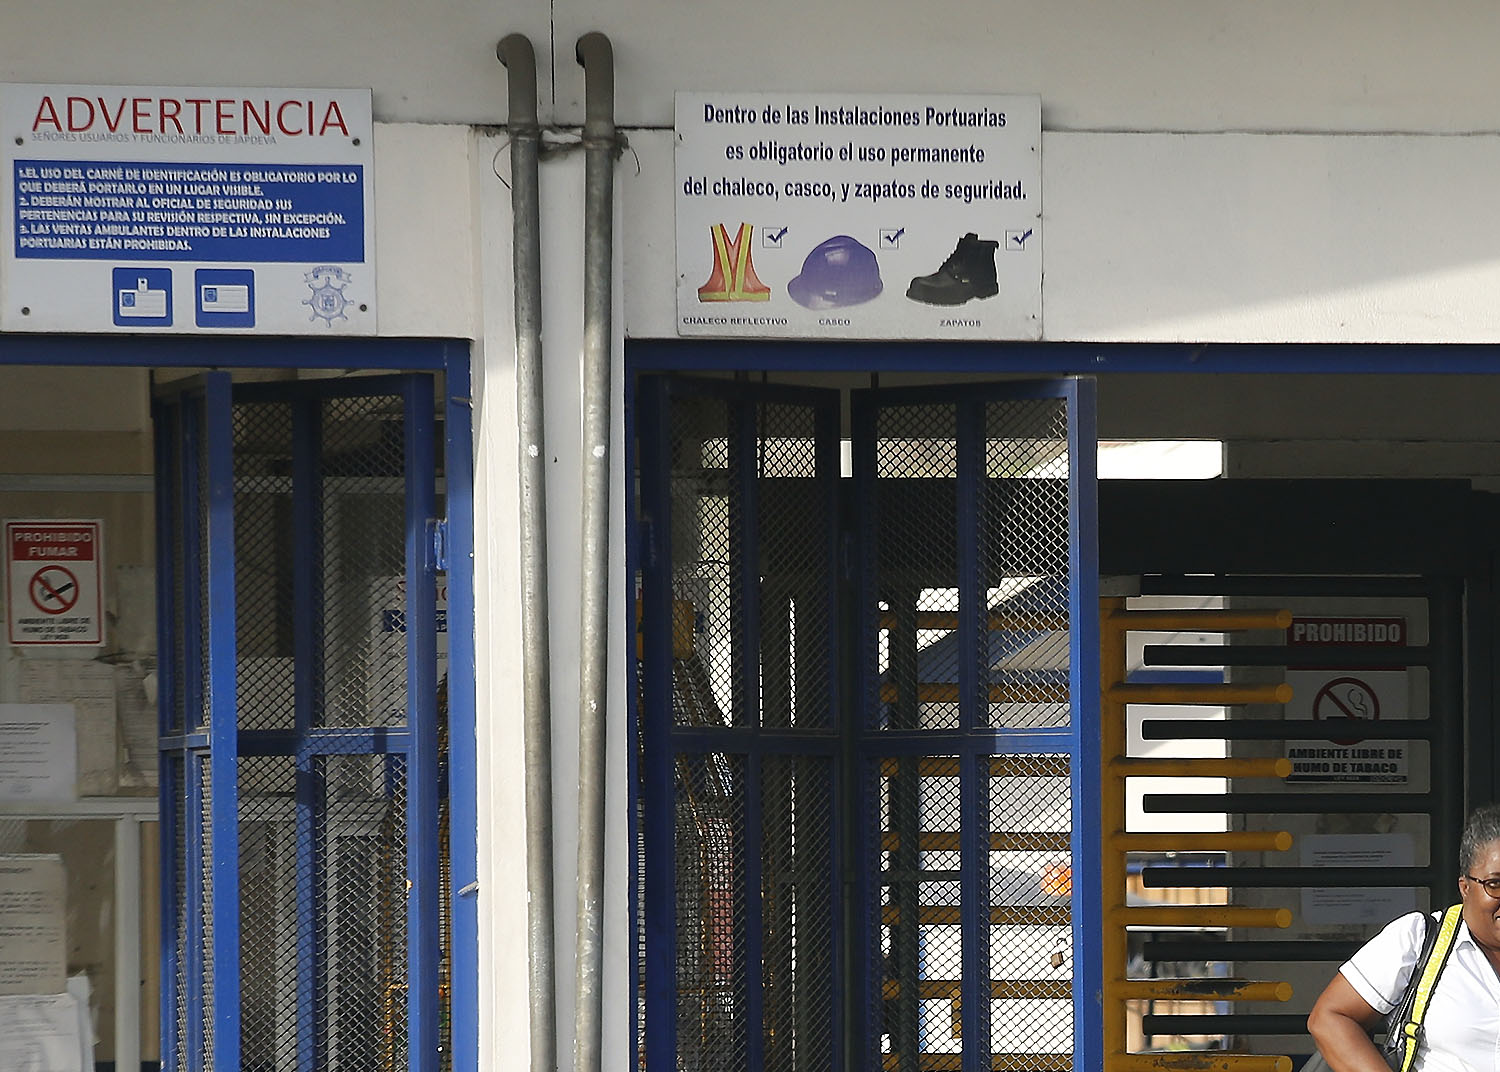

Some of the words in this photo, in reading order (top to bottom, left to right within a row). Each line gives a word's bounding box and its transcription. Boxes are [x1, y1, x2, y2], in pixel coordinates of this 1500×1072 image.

[32, 96, 349, 137] ADVERTENCIA
[704, 104, 757, 124] Dentro
[762, 105, 781, 125] de
[786, 105, 809, 125] las
[815, 105, 921, 127] Instalaciones
[925, 106, 1007, 128] Portuarias
[78, 133, 129, 144] USUARIOS
[140, 134, 215, 145] FUNCIONARIOS
[217, 136, 231, 145] DE
[725, 145, 744, 160] es
[749, 141, 834, 165] obligatorio
[839, 142, 853, 161] el
[858, 147, 886, 162] uso
[890, 144, 986, 167] permanente
[40, 168, 62, 180] USO
[63, 168, 85, 180] DEL
[86, 166, 124, 181] CARNÉ
[125, 168, 141, 181] DE
[142, 168, 228, 182] IDENTIFICACIÓN
[229, 171, 242, 182] ES
[243, 171, 316, 184] OBLIGATORIO
[317, 172, 341, 184] POR
[342, 173, 358, 184] LO
[19, 181, 43, 193] QUE
[43, 181, 87, 194] DEBERÁ
[88, 182, 147, 195] PORTARLO
[149, 183, 164, 195] EN
[165, 183, 182, 195] UN
[184, 184, 221, 196] LUGAR
[222, 184, 264, 197] VISIBLE.
[683, 176, 707, 196] del
[712, 177, 779, 201] chaleco,
[784, 182, 836, 202] casco,
[841, 183, 850, 203] y
[854, 179, 916, 203] zapatos
[920, 179, 940, 199] de
[944, 179, 1027, 204] seguridad.
[31, 194, 83, 207] DEBERÁN
[83, 195, 135, 208] MOSTRAR
[135, 196, 151, 208] AL
[151, 196, 195, 209] OFICIAL
[196, 198, 212, 210] DE
[213, 198, 273, 210] SEGURIDAD
[274, 200, 293, 211] SUS
[19, 210, 99, 221] PERTENENCIAS
[100, 210, 131, 222] PARA
[132, 211, 146, 222] SU
[146, 209, 196, 223] REVISIÓN
[197, 212, 263, 225] RESPECTIVA,
[264, 213, 282, 224] SIN
[283, 212, 347, 225] EXCEPCIÓN.
[31, 224, 51, 235] LAS
[52, 224, 93, 236] VENTAS
[94, 225, 165, 237] AMBULANTES
[166, 226, 210, 238] DENTRO
[212, 227, 228, 238] DE
[229, 227, 249, 238] LAS
[250, 227, 331, 239] INSTALACIONES
[20, 238, 88, 249] PORTUARIAS
[89, 237, 124, 250] ESTÁN
[124, 239, 193, 251] PROHIBIDAS.
[683, 317, 727, 325] CHALECO
[819, 318, 851, 327] CASCO
[939, 319, 982, 328] ZAPATOS
[15, 532, 92, 543] PROHIBIDO
[28, 546, 79, 557] FUMAR
[1293, 623, 1401, 643] PROHIBIDO
[1288, 748, 1349, 760] AMBIENTE
[1351, 749, 1385, 760] LIBRE
[1388, 750, 1403, 760] DE
[1293, 762, 1330, 773] HUMO
[1333, 763, 1348, 773] DE
[1350, 762, 1398, 774] TABACO
